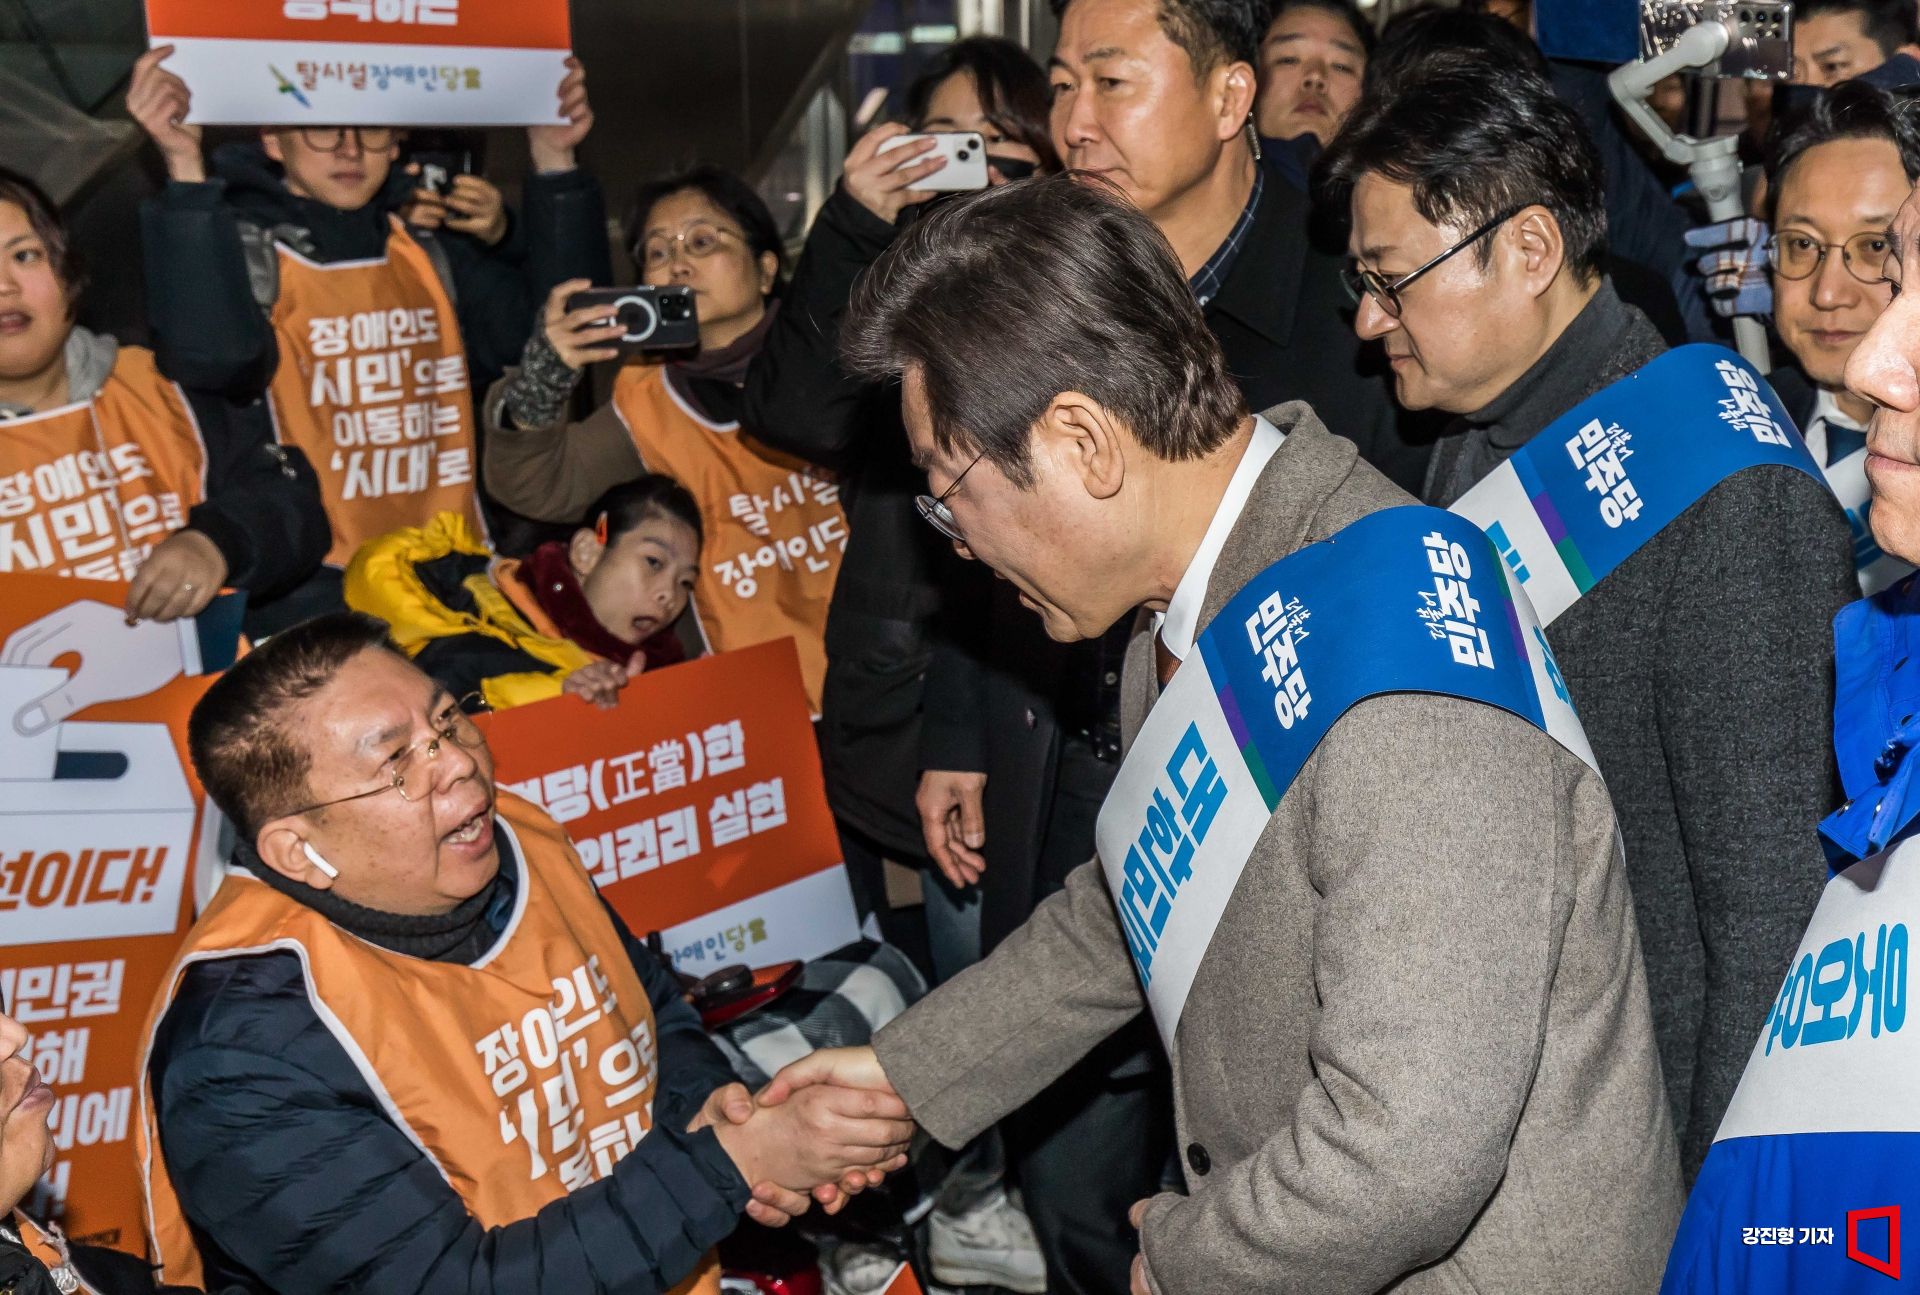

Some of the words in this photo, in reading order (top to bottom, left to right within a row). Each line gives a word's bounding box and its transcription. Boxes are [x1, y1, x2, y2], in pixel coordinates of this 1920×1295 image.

[308, 308, 438, 356] 장애인도
[333, 403, 461, 447] 이동하는
[1715, 359, 1792, 448] 민주당
[1565, 418, 1644, 529] 민주당
[1422, 531, 1495, 670] 민주당
[1245, 590, 1312, 730] 민주당
[708, 776, 788, 848] 실현
[21, 1028, 90, 1086] 해
